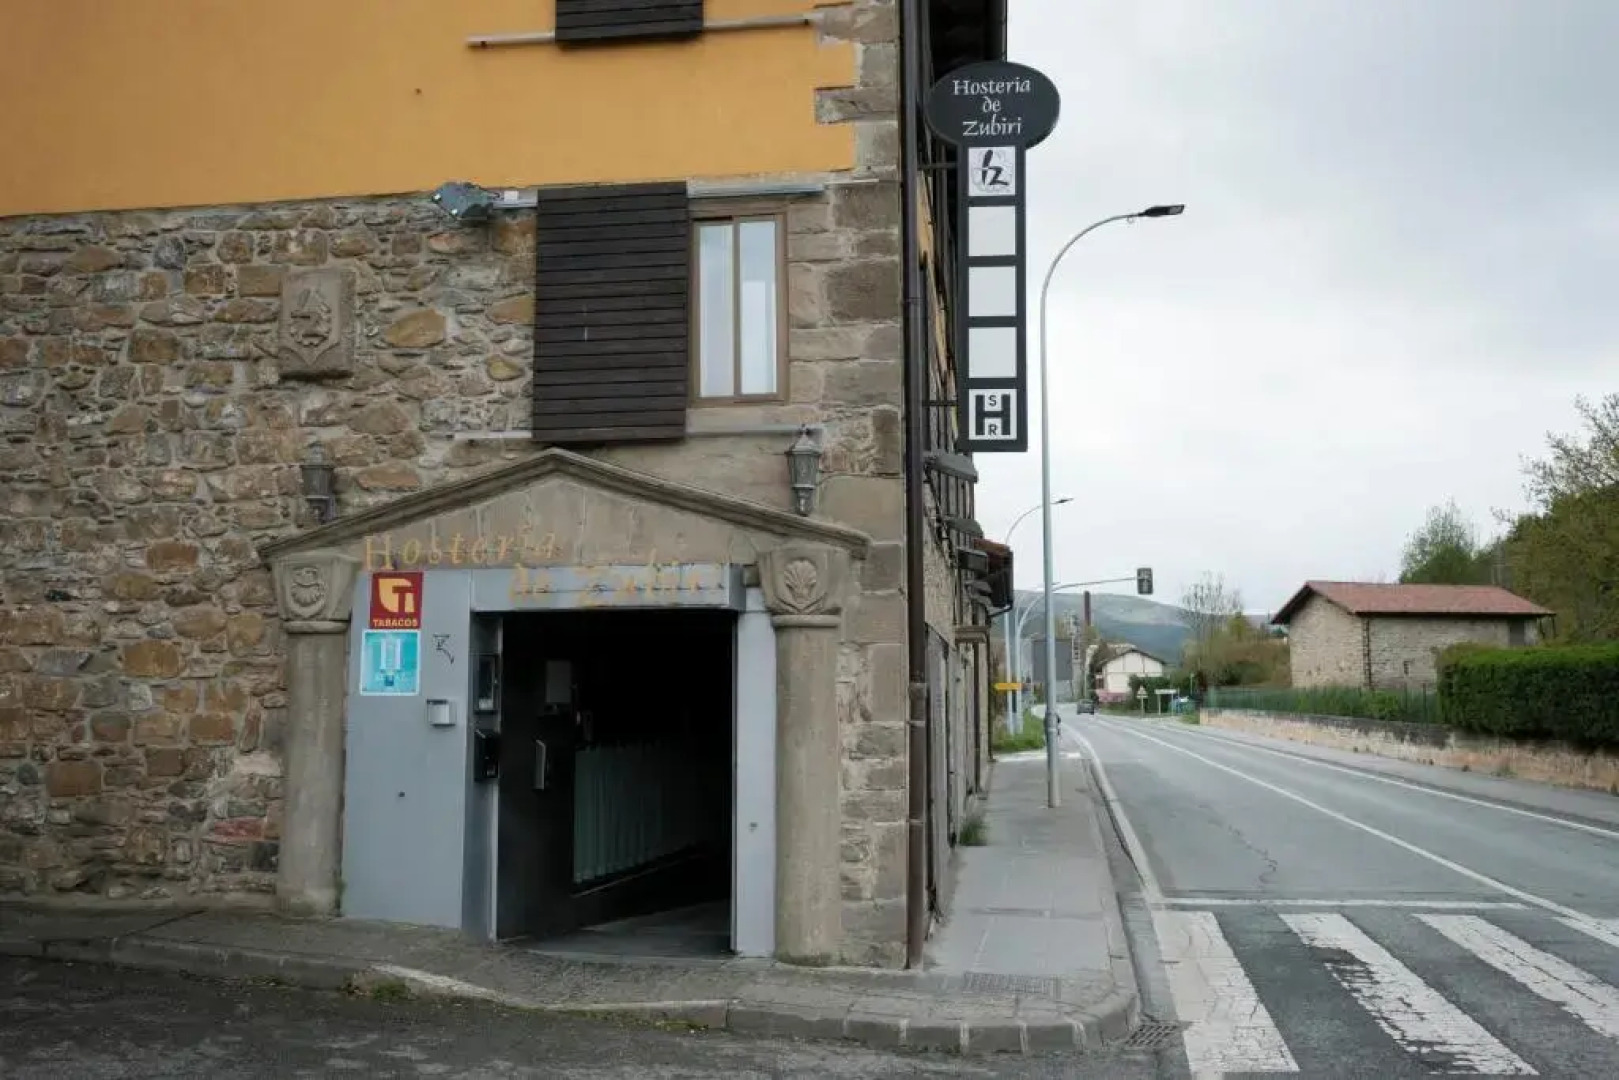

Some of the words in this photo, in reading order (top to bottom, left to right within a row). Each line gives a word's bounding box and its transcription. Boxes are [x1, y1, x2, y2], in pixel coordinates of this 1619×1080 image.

[982, 96, 1001, 112] de
[962, 114, 1022, 137] Zubiri
[372, 619, 418, 627] TABACOS
